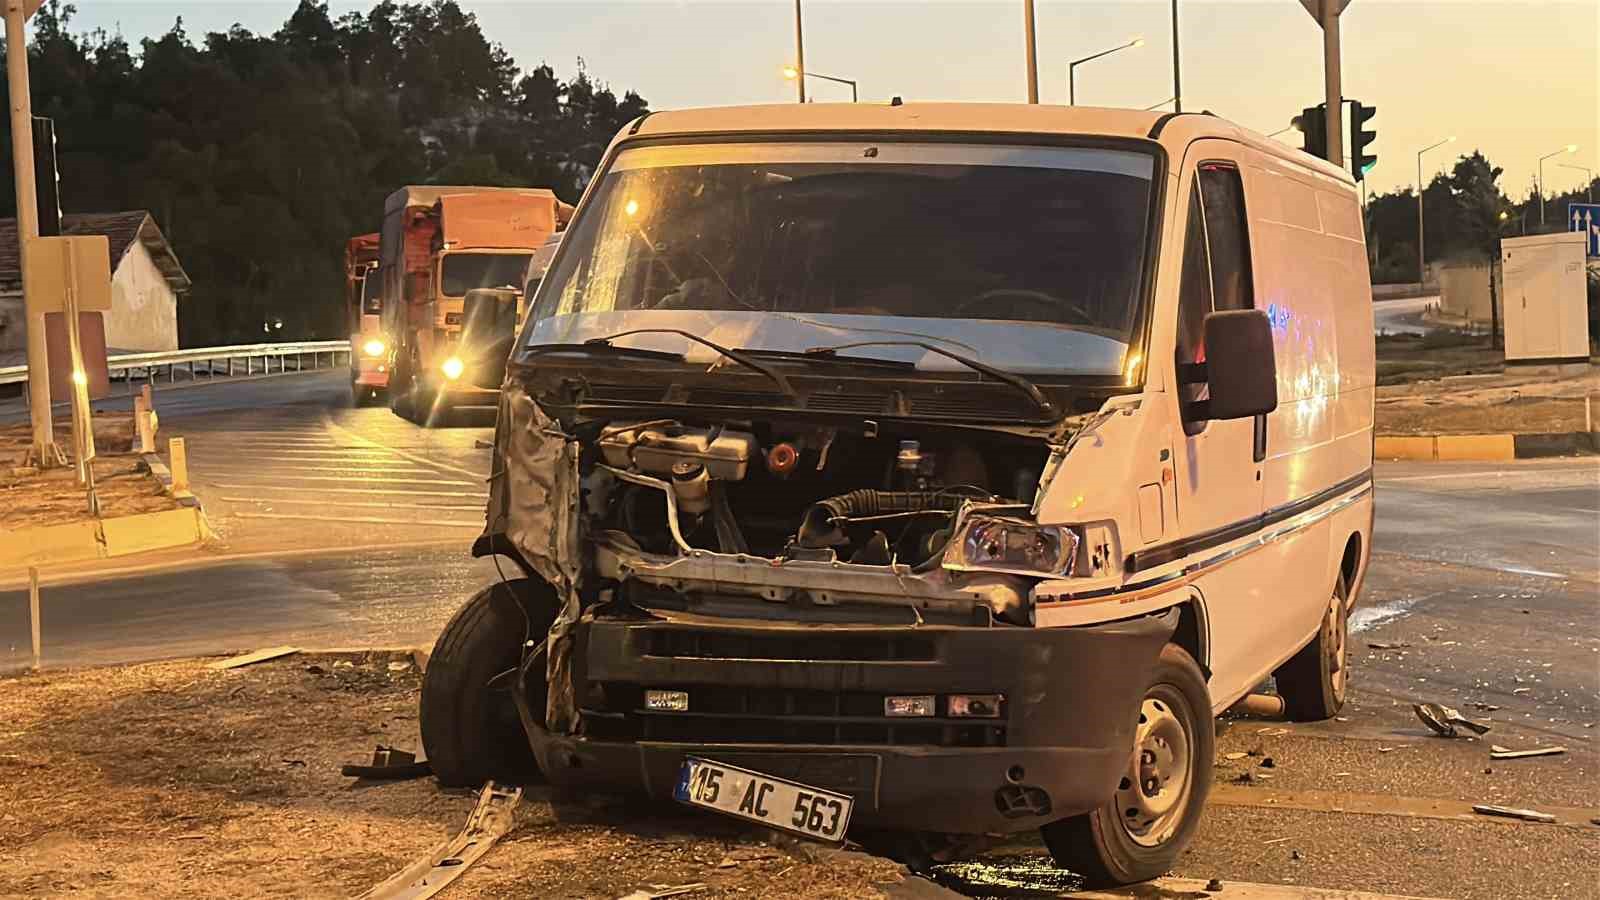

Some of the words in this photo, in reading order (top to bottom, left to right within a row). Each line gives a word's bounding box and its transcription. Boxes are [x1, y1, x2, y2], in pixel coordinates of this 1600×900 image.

[696, 767, 724, 803] 15
[739, 779, 774, 817] AC
[792, 792, 842, 836] 563
